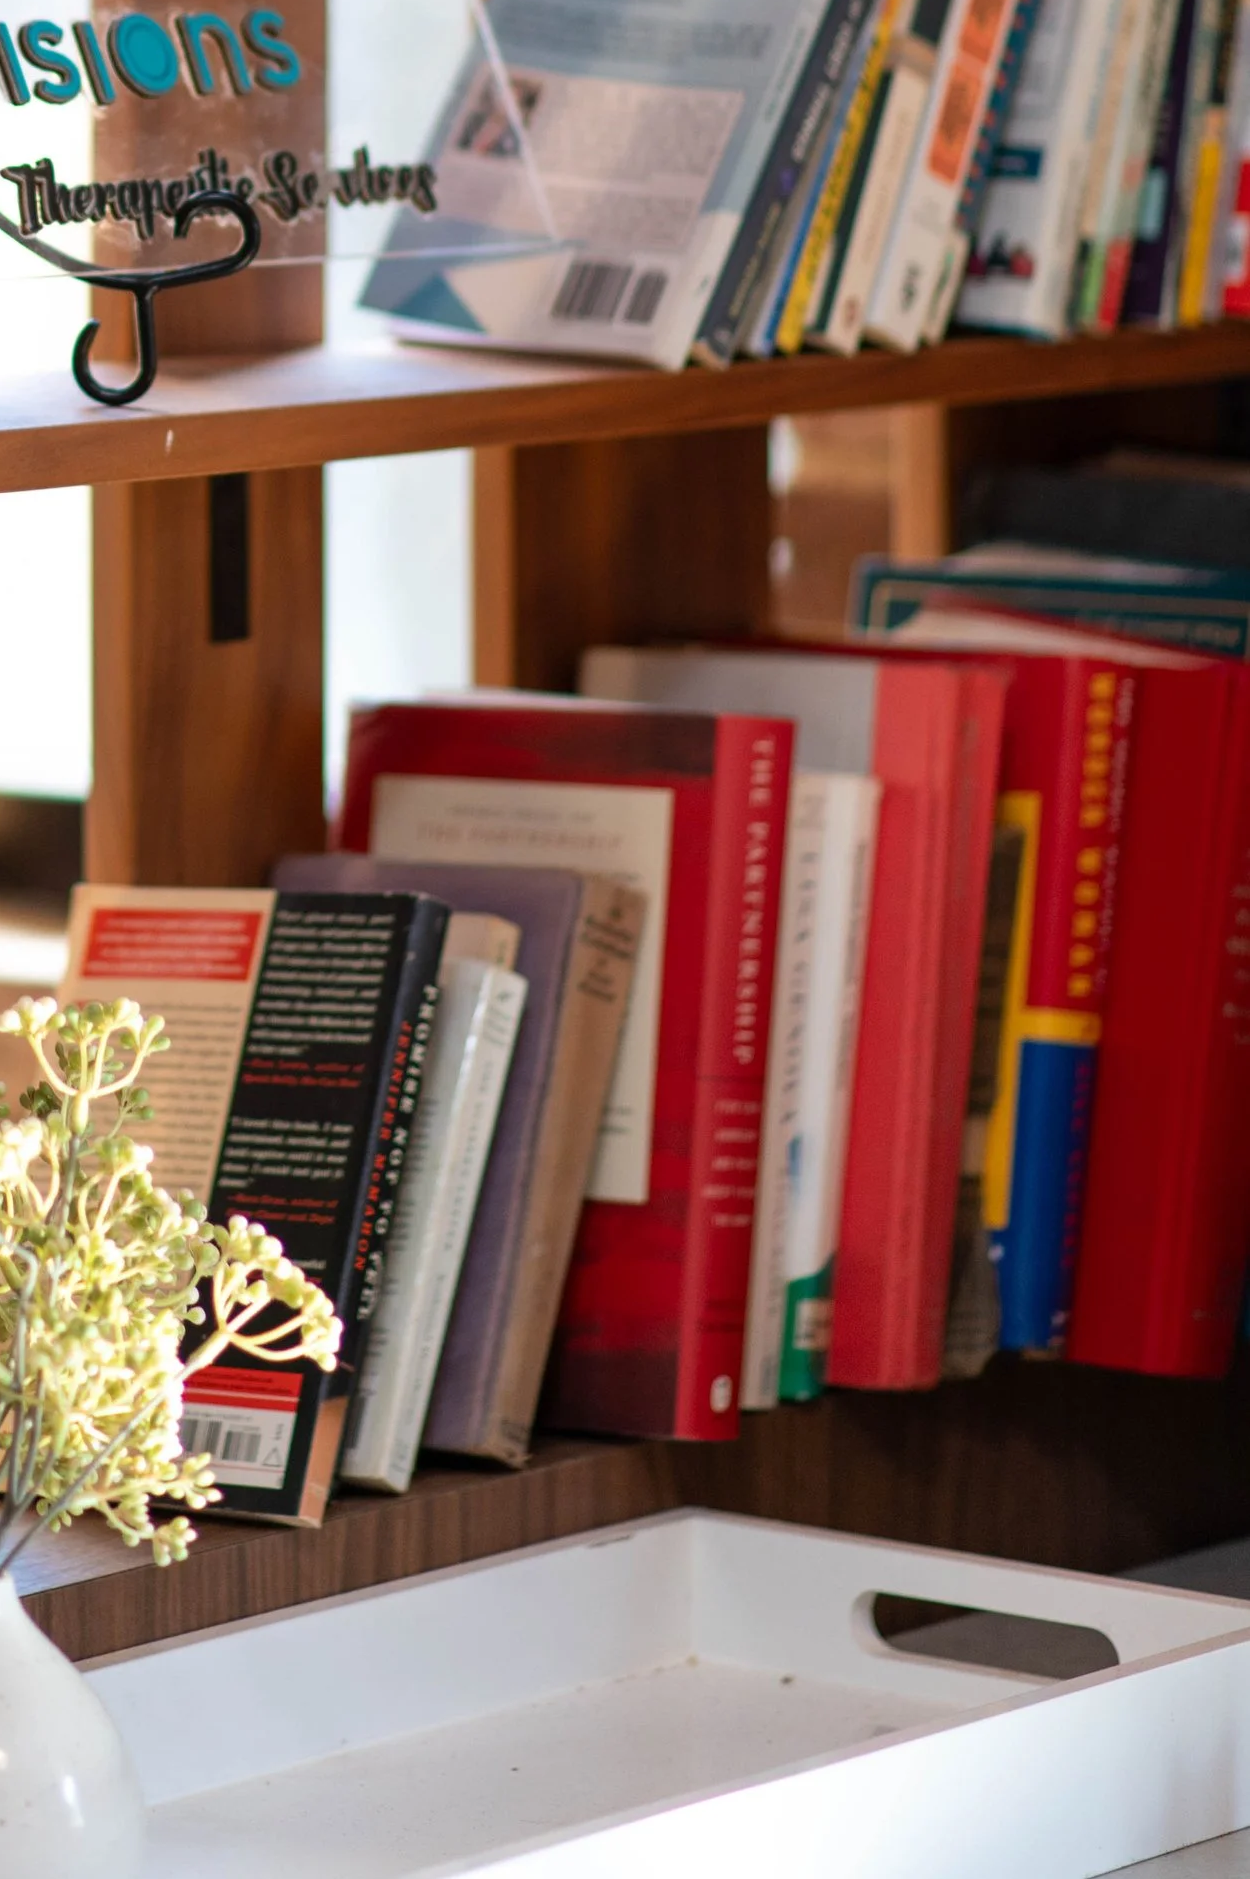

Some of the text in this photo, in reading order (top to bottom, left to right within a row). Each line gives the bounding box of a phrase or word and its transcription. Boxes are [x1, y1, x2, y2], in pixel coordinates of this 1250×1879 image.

[255, 142, 437, 220] Sevices
[748, 737, 776, 808] THE
[732, 821, 771, 1065] PARTNERSHIP
[379, 1021, 414, 1141] JENNIFER
[398, 984, 440, 1114] PROMISE
[384, 1127, 410, 1186] NOT
[373, 1199, 395, 1235] TO
